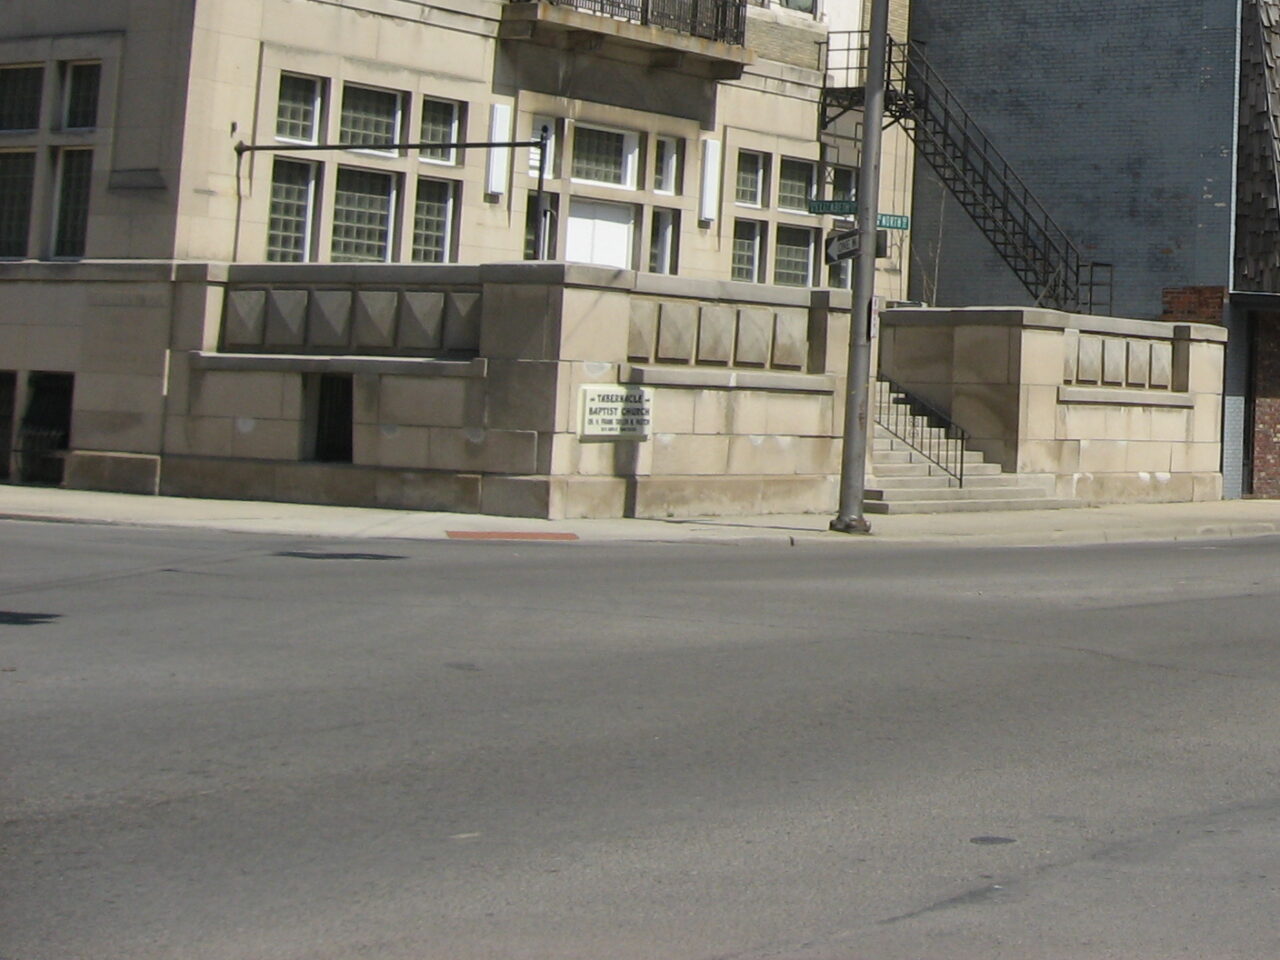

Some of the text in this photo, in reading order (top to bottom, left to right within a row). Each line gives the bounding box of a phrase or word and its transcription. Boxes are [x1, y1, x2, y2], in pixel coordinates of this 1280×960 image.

[597, 394, 643, 403] TABERNACLE
[588, 407, 650, 416] BAPTIST CHURCH
